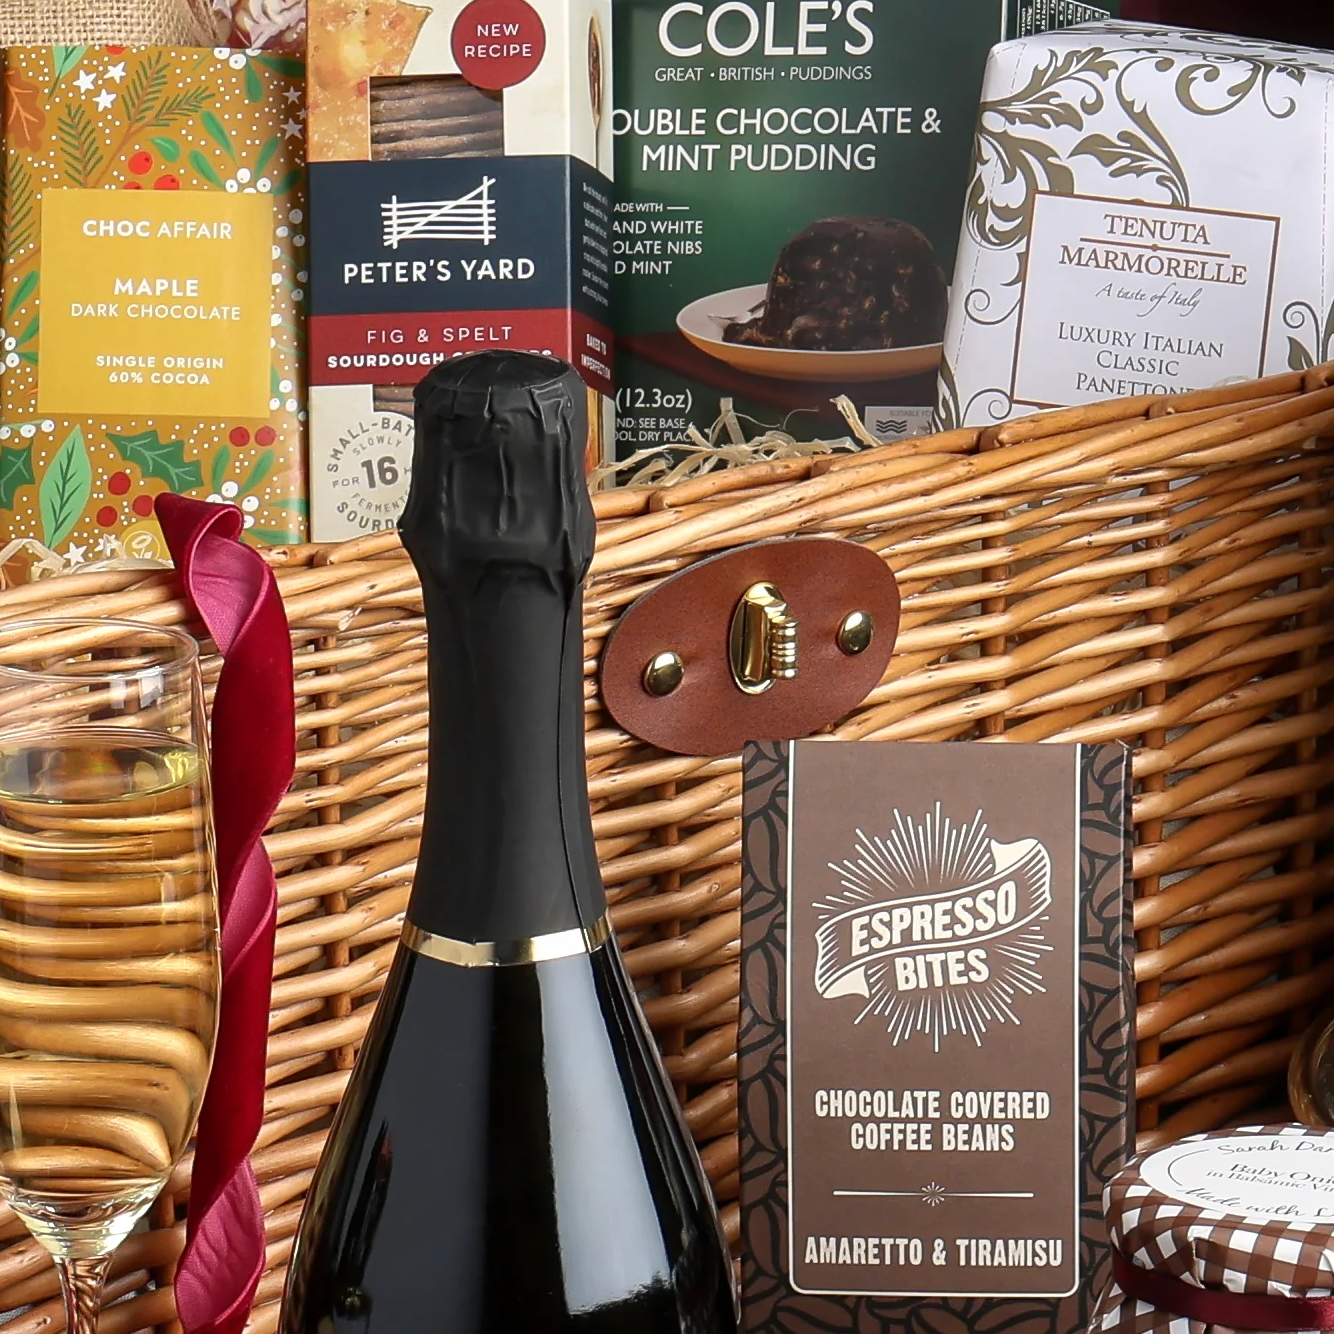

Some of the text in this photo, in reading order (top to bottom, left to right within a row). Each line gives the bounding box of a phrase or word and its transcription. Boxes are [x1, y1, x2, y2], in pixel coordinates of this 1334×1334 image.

[476, 23, 519, 37] NEW
[658, 0, 875, 57] COLE'S
[464, 43, 532, 58] RECIPE
[655, 66, 872, 82] GREAT BRITISH PUDDINGS
[612, 107, 941, 135] OUBLE CHOCOLATE &
[642, 144, 876, 171] MINT PUDDING
[82, 220, 232, 239] CHOC AFFAIR
[1103, 214, 1210, 246] TENUTA
[344, 258, 535, 284] PETER'S YARD
[1060, 245, 1247, 285] MARMORELLE
[114, 278, 198, 297] MAPLE
[1096, 283, 1203, 317] A taste of Italy
[71, 303, 240, 320] DARK CHOCOLATE
[366, 326, 513, 344] FIG & SPELT
[1058, 322, 1223, 358] LUXURY ITALIAN
[96, 355, 223, 369] SINGLE ORIGIN
[327, 352, 445, 368] SOURDOUGH
[1096, 351, 1179, 377] CLASSIC
[109, 371, 210, 384] 60% COCOA
[616, 388, 692, 413] (12.3oz)
[361, 456, 399, 489] 16
[851, 880, 1018, 957] ESPRESSO
[895, 949, 989, 992] BITES
[815, 1090, 1050, 1119] CHOCOLATE COVERED
[851, 1123, 1015, 1152] COFFEE BEANS
[804, 1236, 1063, 1267] AMARETTO & TIRAMISU
